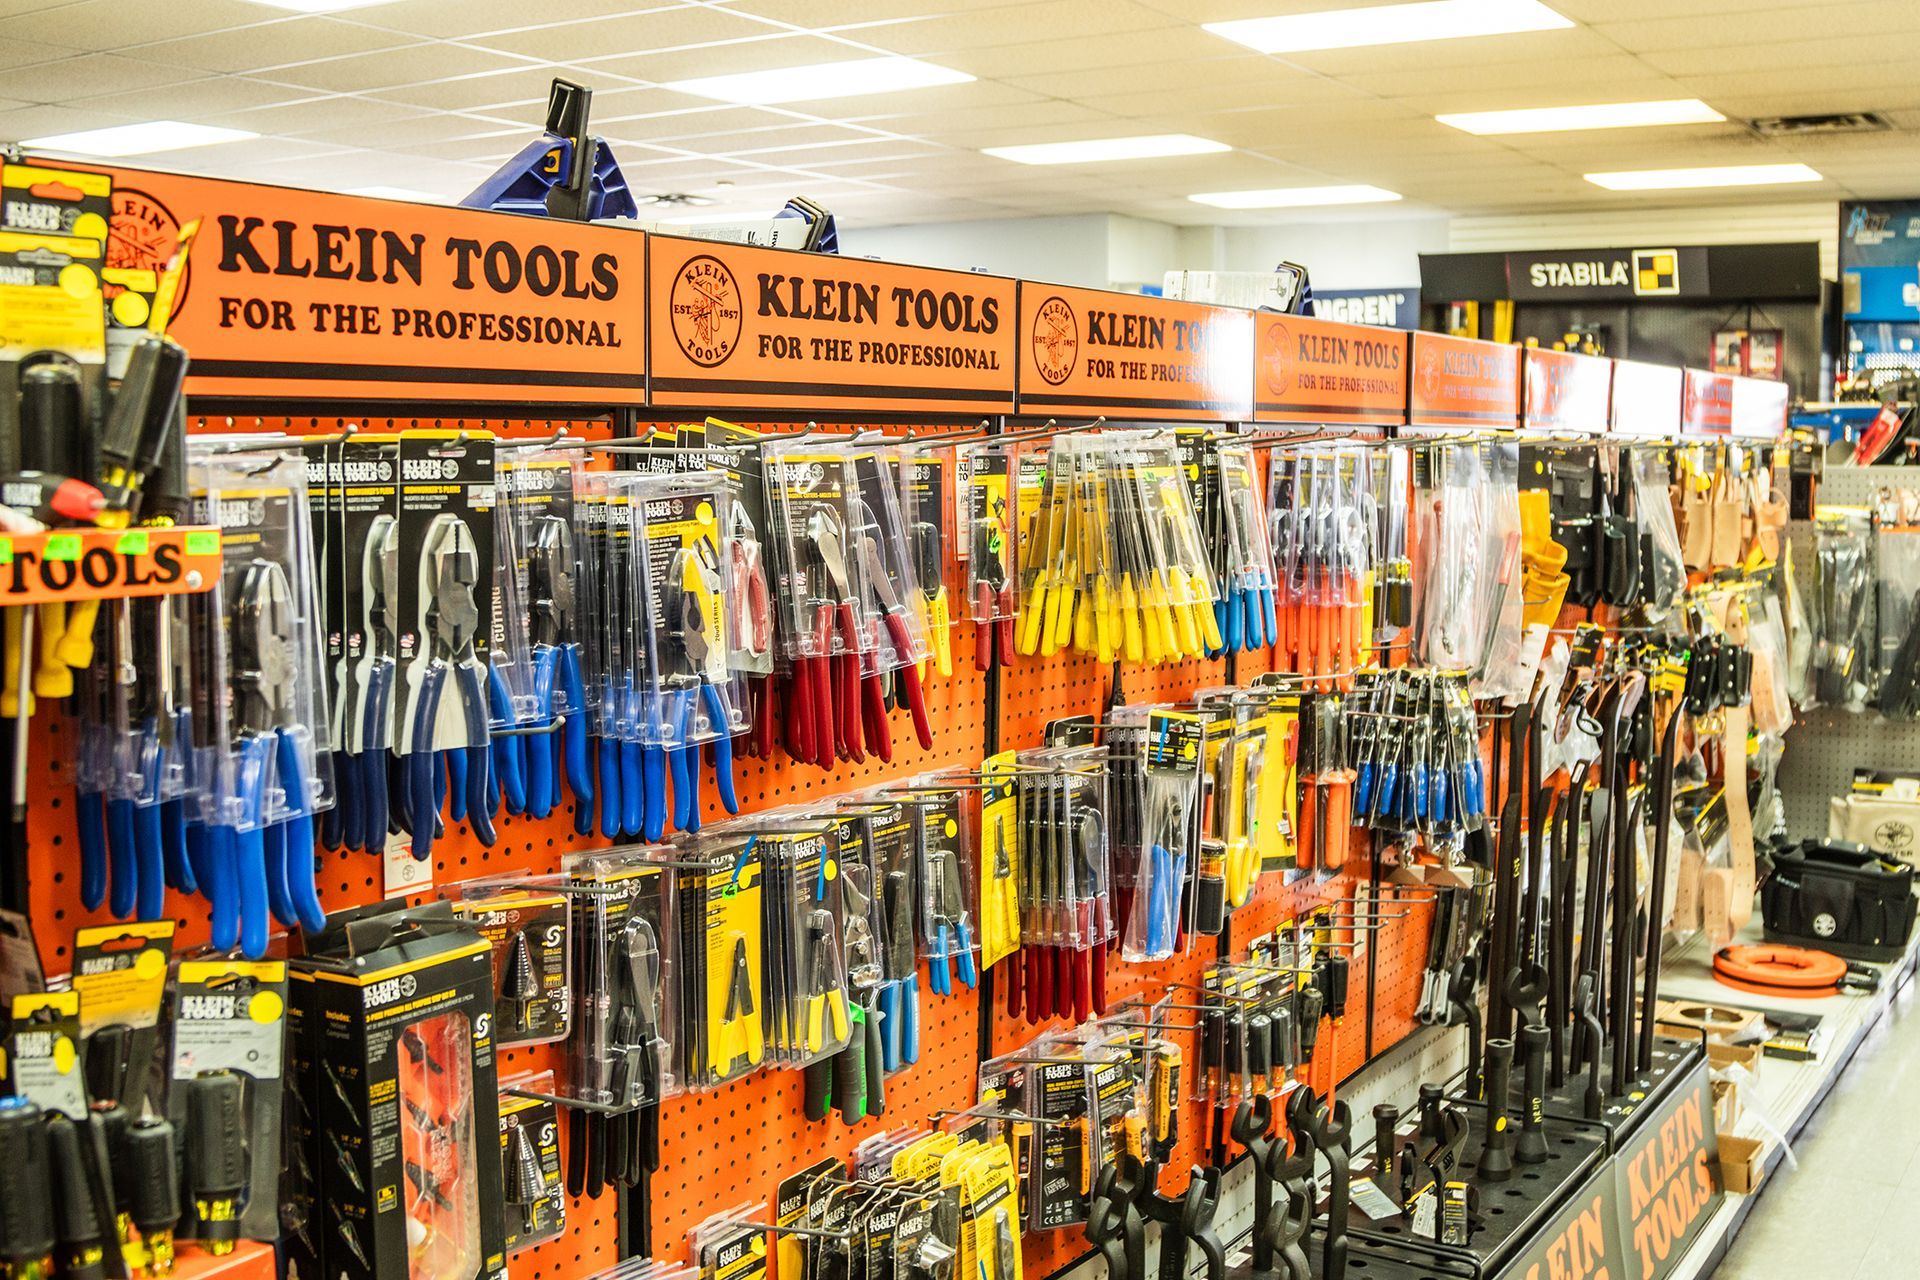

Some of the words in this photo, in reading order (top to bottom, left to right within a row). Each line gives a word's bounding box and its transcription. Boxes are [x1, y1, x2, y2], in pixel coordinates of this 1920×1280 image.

[217, 215, 426, 286] KLEIN
[445, 237, 619, 301] TOOLS
[685, 264, 728, 287] KLEIN
[1530, 260, 1629, 288] STABILA
[674, 304, 693, 315] EST.
[757, 273, 880, 325] KLEIN
[892, 287, 999, 334] TOOLS
[720, 309, 738, 320] 1857
[1042, 303, 1070, 322] KLEIN
[219, 297, 296, 331] FOR
[309, 303, 381, 335] THE
[391, 308, 621, 348] PROFESSIONAL
[1087, 310, 1166, 350] KLEIN
[687, 339, 728, 361] TOOLS
[758, 334, 803, 359] FOR
[811, 337, 853, 362] THE
[859, 341, 1000, 370] PROFESSIONAL
[1298, 333, 1349, 366] KLEIN
[1353, 341, 1400, 370] TOOLS
[1042, 363, 1069, 381] TOOLS
[1087, 359, 1115, 379] FOR
[1120, 362, 1147, 380] THE
[1298, 374, 1317, 389] FOR
[1320, 375, 1337, 391] THE
[1339, 376, 1400, 396] PROFESSIONAL
[344, 462, 378, 472] KLEIN
[403, 459, 441, 470] KLEIN
[344, 471, 378, 482] TOOLS
[403, 469, 441, 480] TOOLS
[645, 501, 671, 511] KLEIN
[646, 508, 672, 518] TOOLS
[8, 544, 181, 593] TOOLS
[492, 586, 505, 642] CUTTING
[795, 838, 816, 850] KLEIN
[795, 848, 816, 860] TOOLS
[362, 978, 399, 998] KLEIN
[182, 995, 236, 1011] KLEIN
[365, 989, 401, 1009] TOOLS
[182, 1006, 235, 1019] TOOLS
[1045, 1064, 1072, 1075] KLEIN
[1045, 1070, 1072, 1080] TOOLS
[1097, 1067, 1115, 1081] KLEIN
[1098, 1074, 1116, 1086] TOOLS
[1628, 1088, 1703, 1221] KLEIN
[780, 1194, 802, 1209] KLEIN
[780, 1200, 801, 1216] TOOLS
[870, 1211, 897, 1225] KLEIN
[1634, 1148, 1711, 1280] TOOLS
[870, 1219, 897, 1233] TOOLS
[900, 1215, 923, 1230] KLEIN
[900, 1222, 923, 1238] TOOLS
[720, 1242, 742, 1259] KLEIN
[720, 1250, 742, 1267] TOOLS
